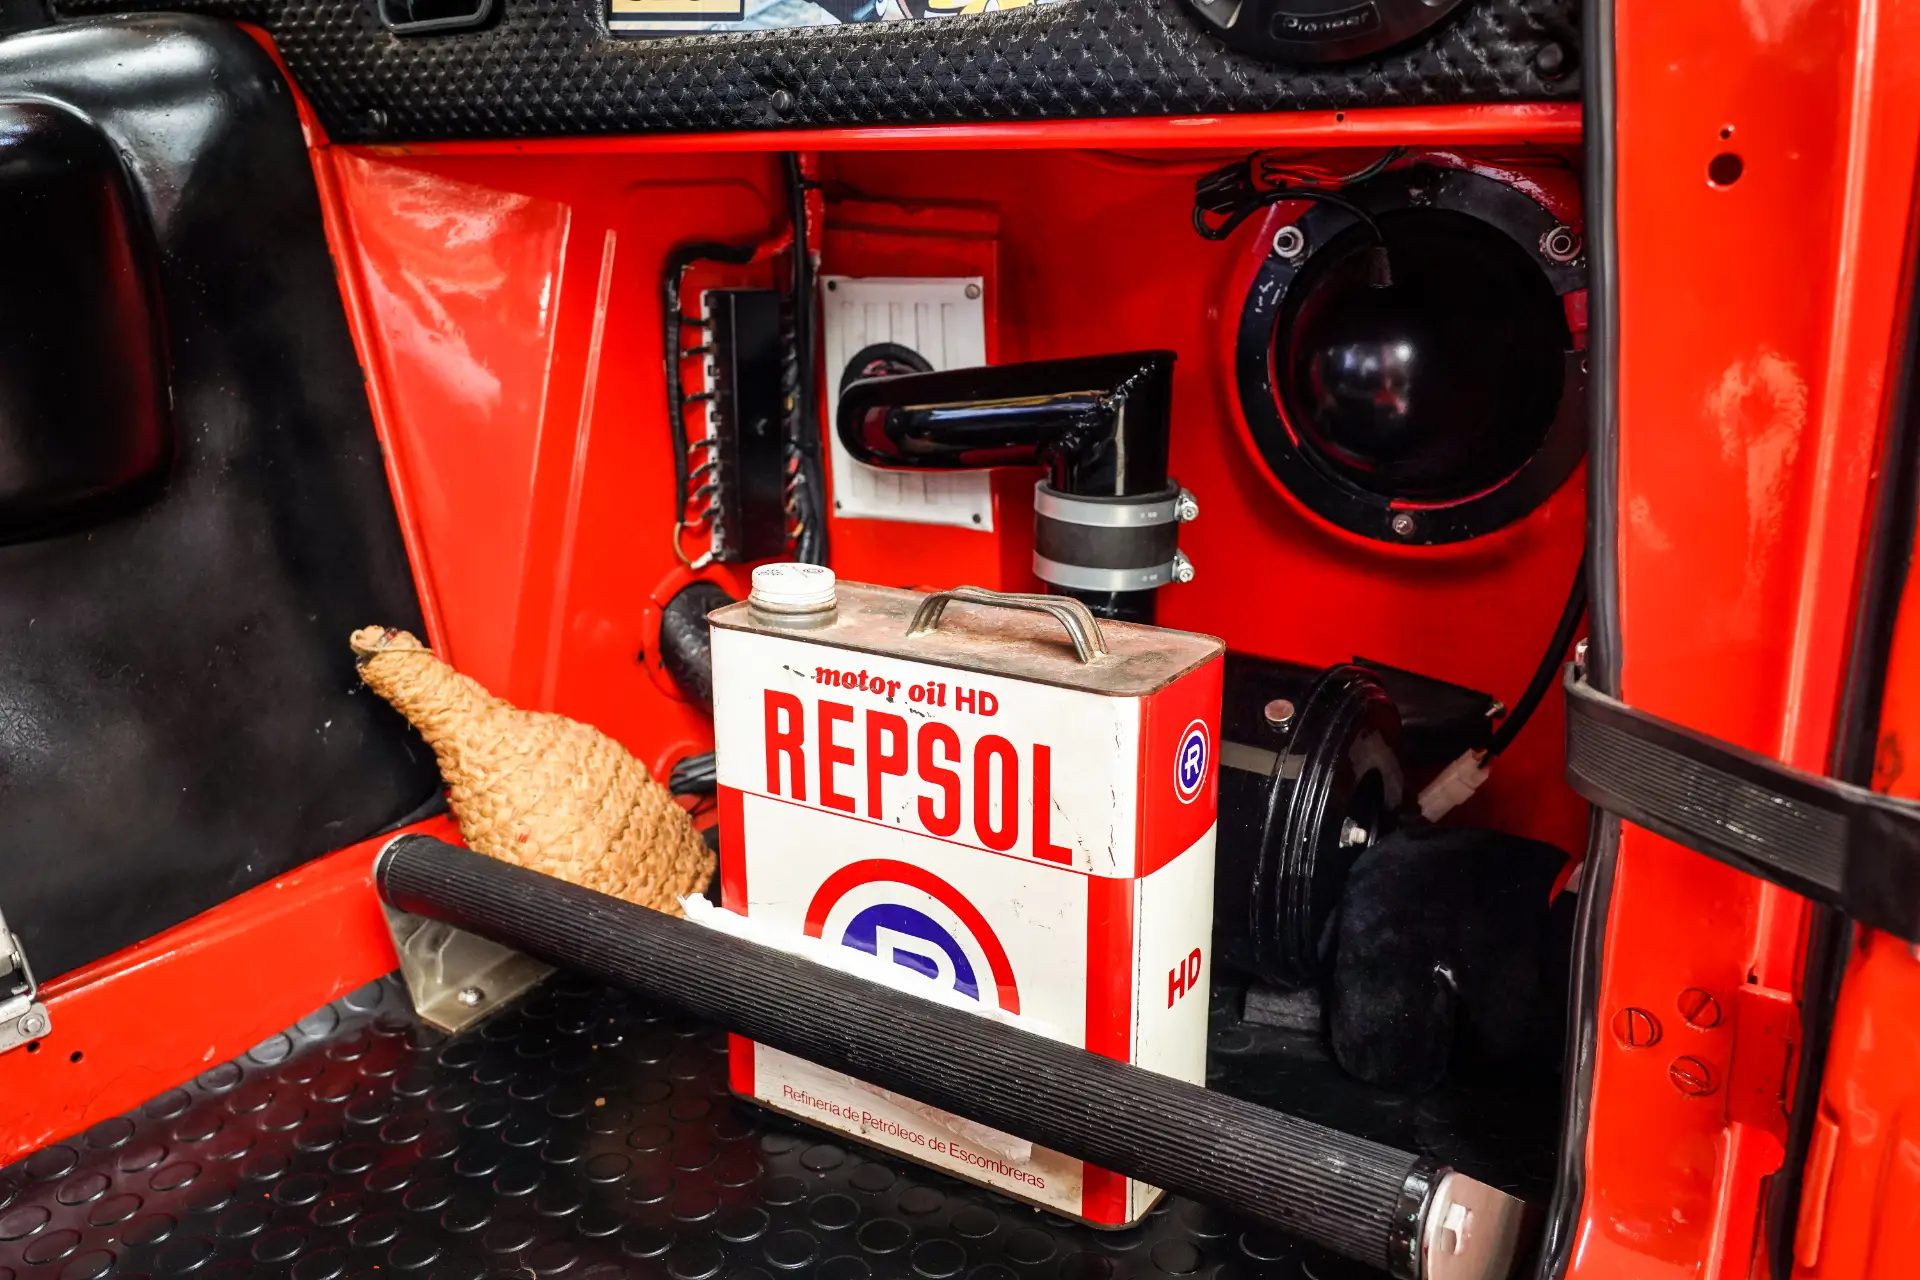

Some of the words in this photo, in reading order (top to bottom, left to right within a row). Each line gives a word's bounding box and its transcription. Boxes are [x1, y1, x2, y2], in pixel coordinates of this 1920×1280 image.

[1282, 12, 1369, 32] Pioneer
[815, 666, 901, 699] motor
[908, 681, 947, 708] oil
[955, 686, 999, 717] HD
[764, 689, 1073, 866] REPSOL
[1167, 947, 1202, 1009] HD
[842, 1105, 861, 1123] de
[861, 1110, 926, 1147] Petróleos
[928, 1137, 947, 1154] de
[948, 1142, 1045, 1189] Escombreras
